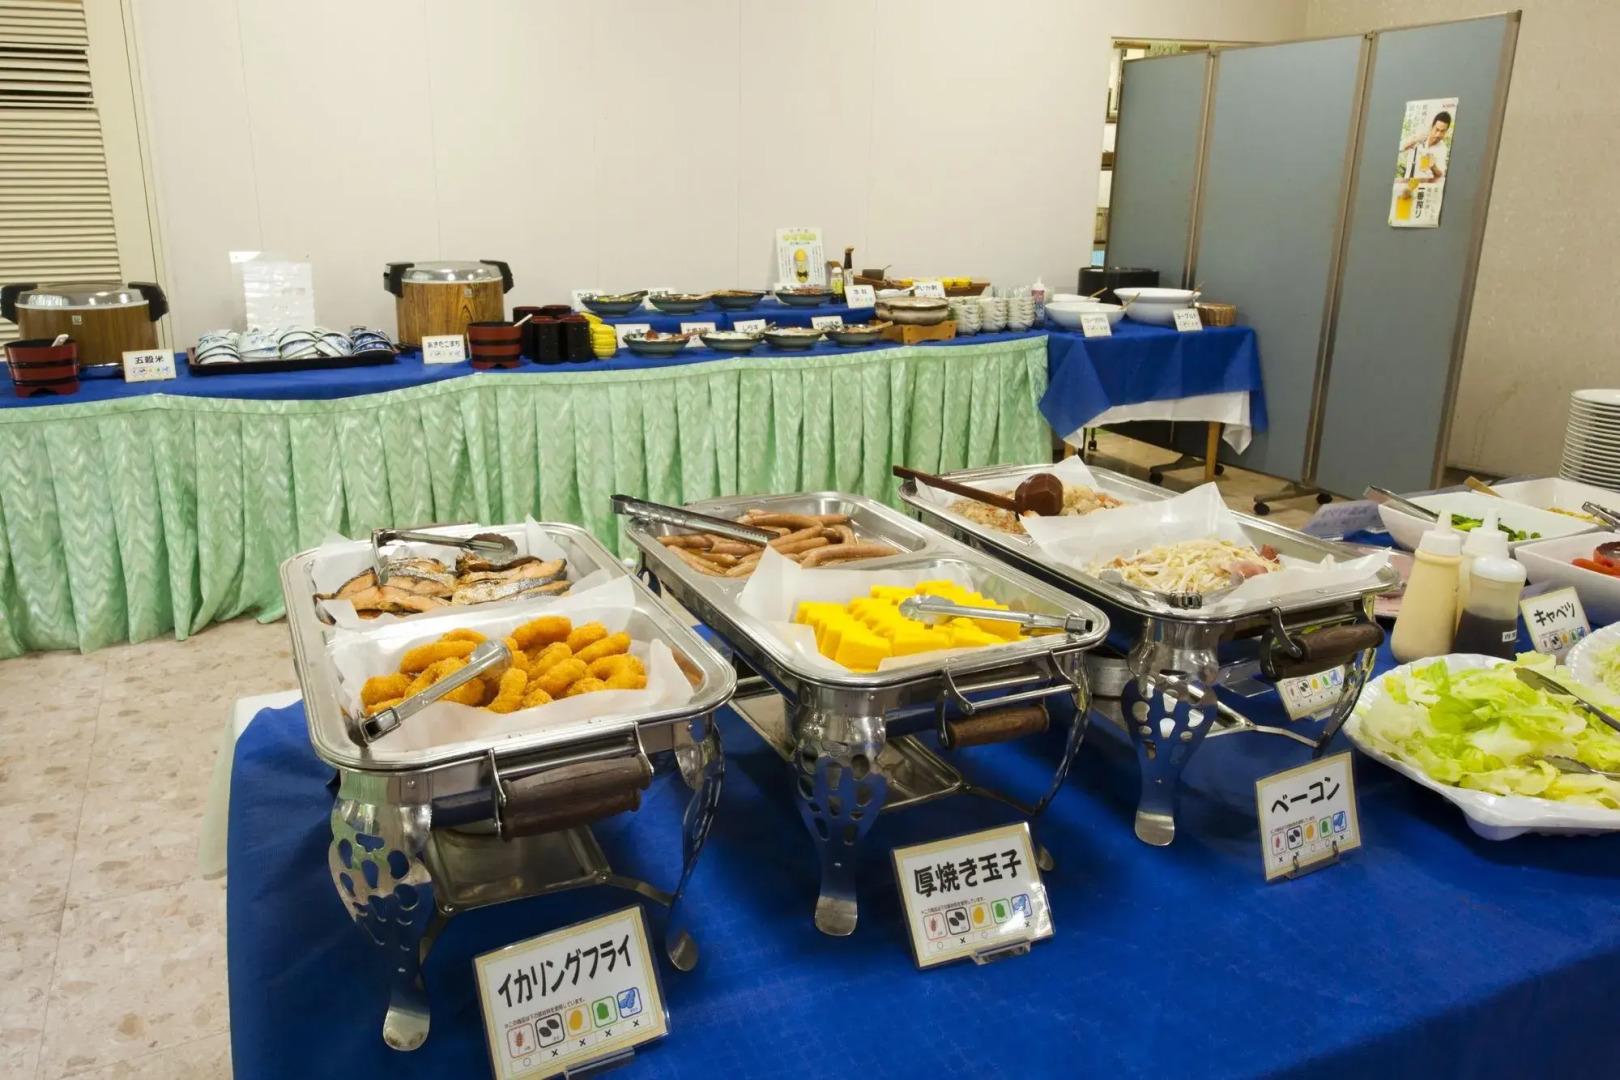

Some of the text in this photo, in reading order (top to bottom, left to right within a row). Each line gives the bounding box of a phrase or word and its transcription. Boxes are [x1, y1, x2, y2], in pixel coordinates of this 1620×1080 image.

[134, 354, 165, 365] 五穀米
[427, 340, 461, 349] あきたこまち
[1534, 601, 1576, 627] キャベツ
[1271, 776, 1340, 813] ベーコン
[914, 849, 1022, 898] 厚焼き玉子
[497, 934, 631, 1008] イカリングフライ
